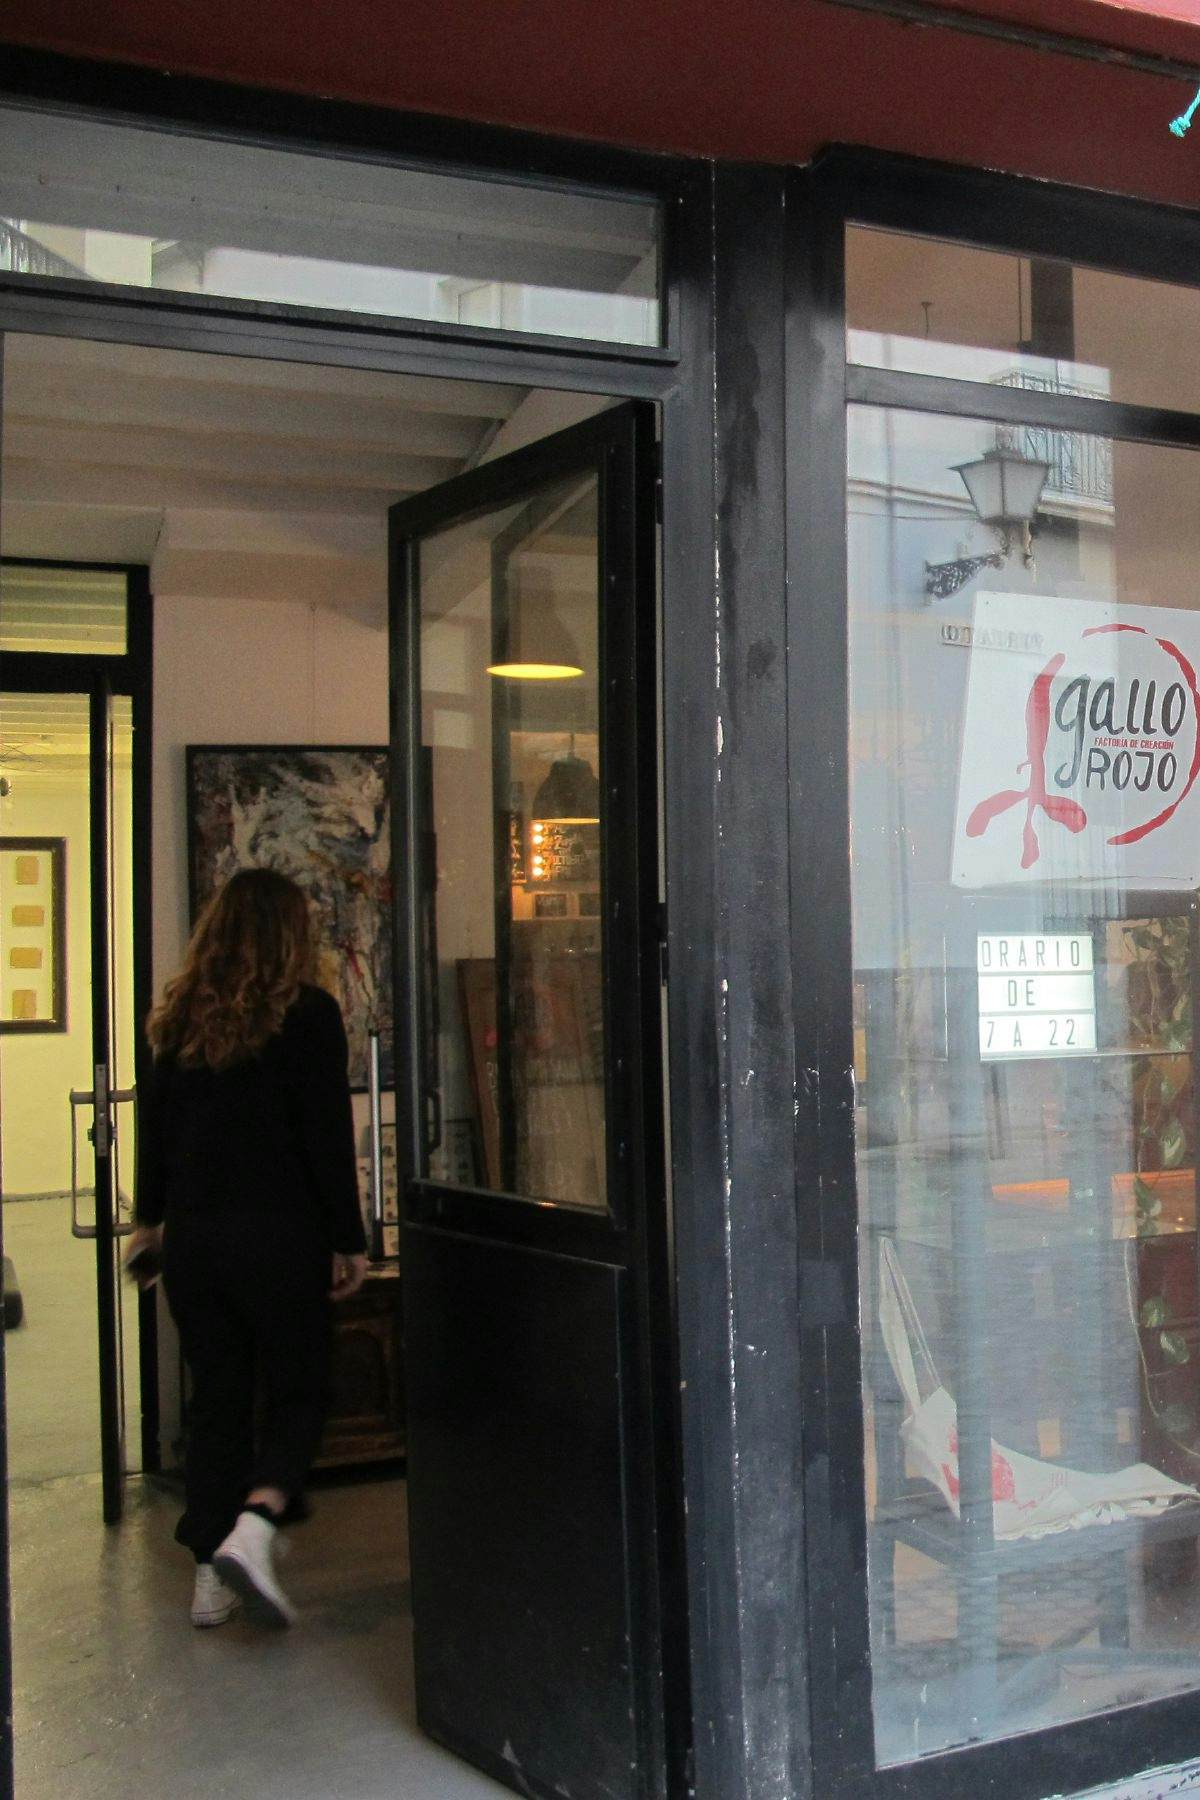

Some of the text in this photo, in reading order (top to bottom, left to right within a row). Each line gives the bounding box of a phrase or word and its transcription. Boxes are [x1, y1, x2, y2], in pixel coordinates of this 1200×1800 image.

[1129, 740, 1138, 748] DE
[1085, 747, 1178, 792] ROJO
[981, 940, 1080, 967] ORARIO
[1008, 979, 1036, 1007] DE
[987, 1018, 1076, 1048] 7 A 22
